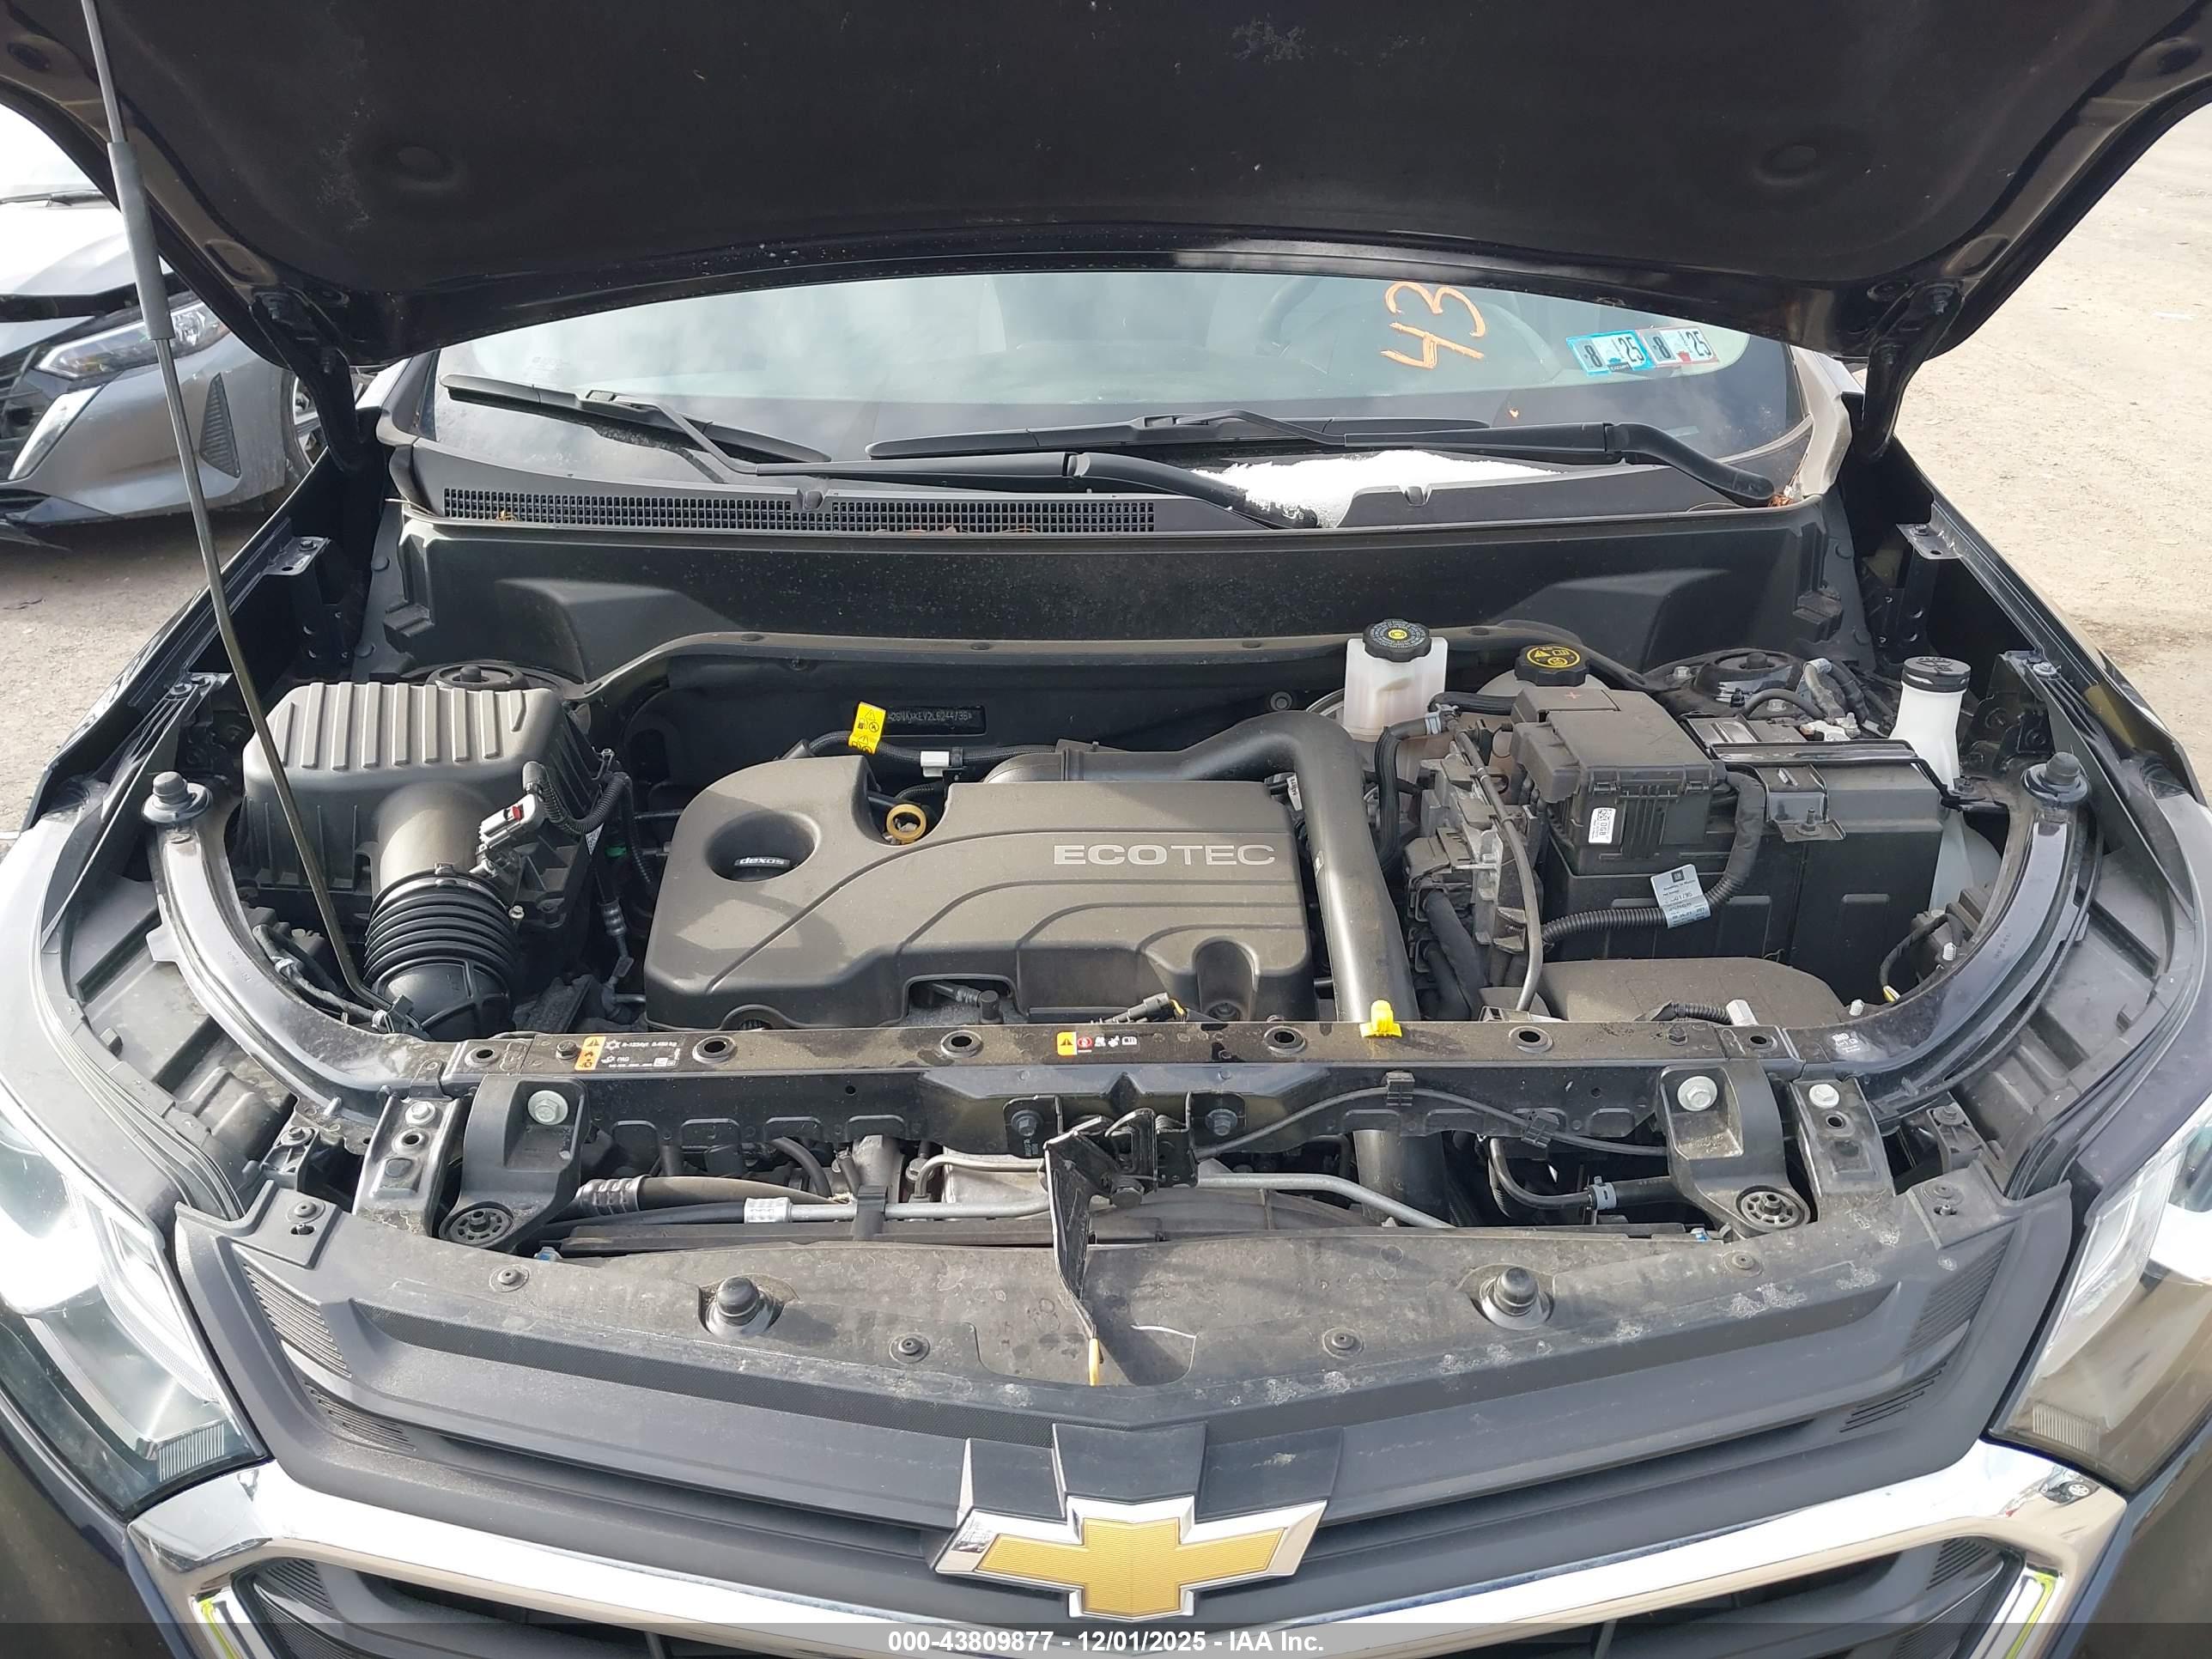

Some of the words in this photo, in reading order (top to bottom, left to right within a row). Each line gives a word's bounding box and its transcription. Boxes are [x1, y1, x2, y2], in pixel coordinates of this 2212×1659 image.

[1381, 282, 1486, 369] 43
[1584, 344, 1603, 368] 8
[1618, 336, 1644, 362] 25
[1653, 336, 1672, 359] 8
[1685, 331, 1712, 356] 25
[1054, 844, 1275, 866] ECOTEC
